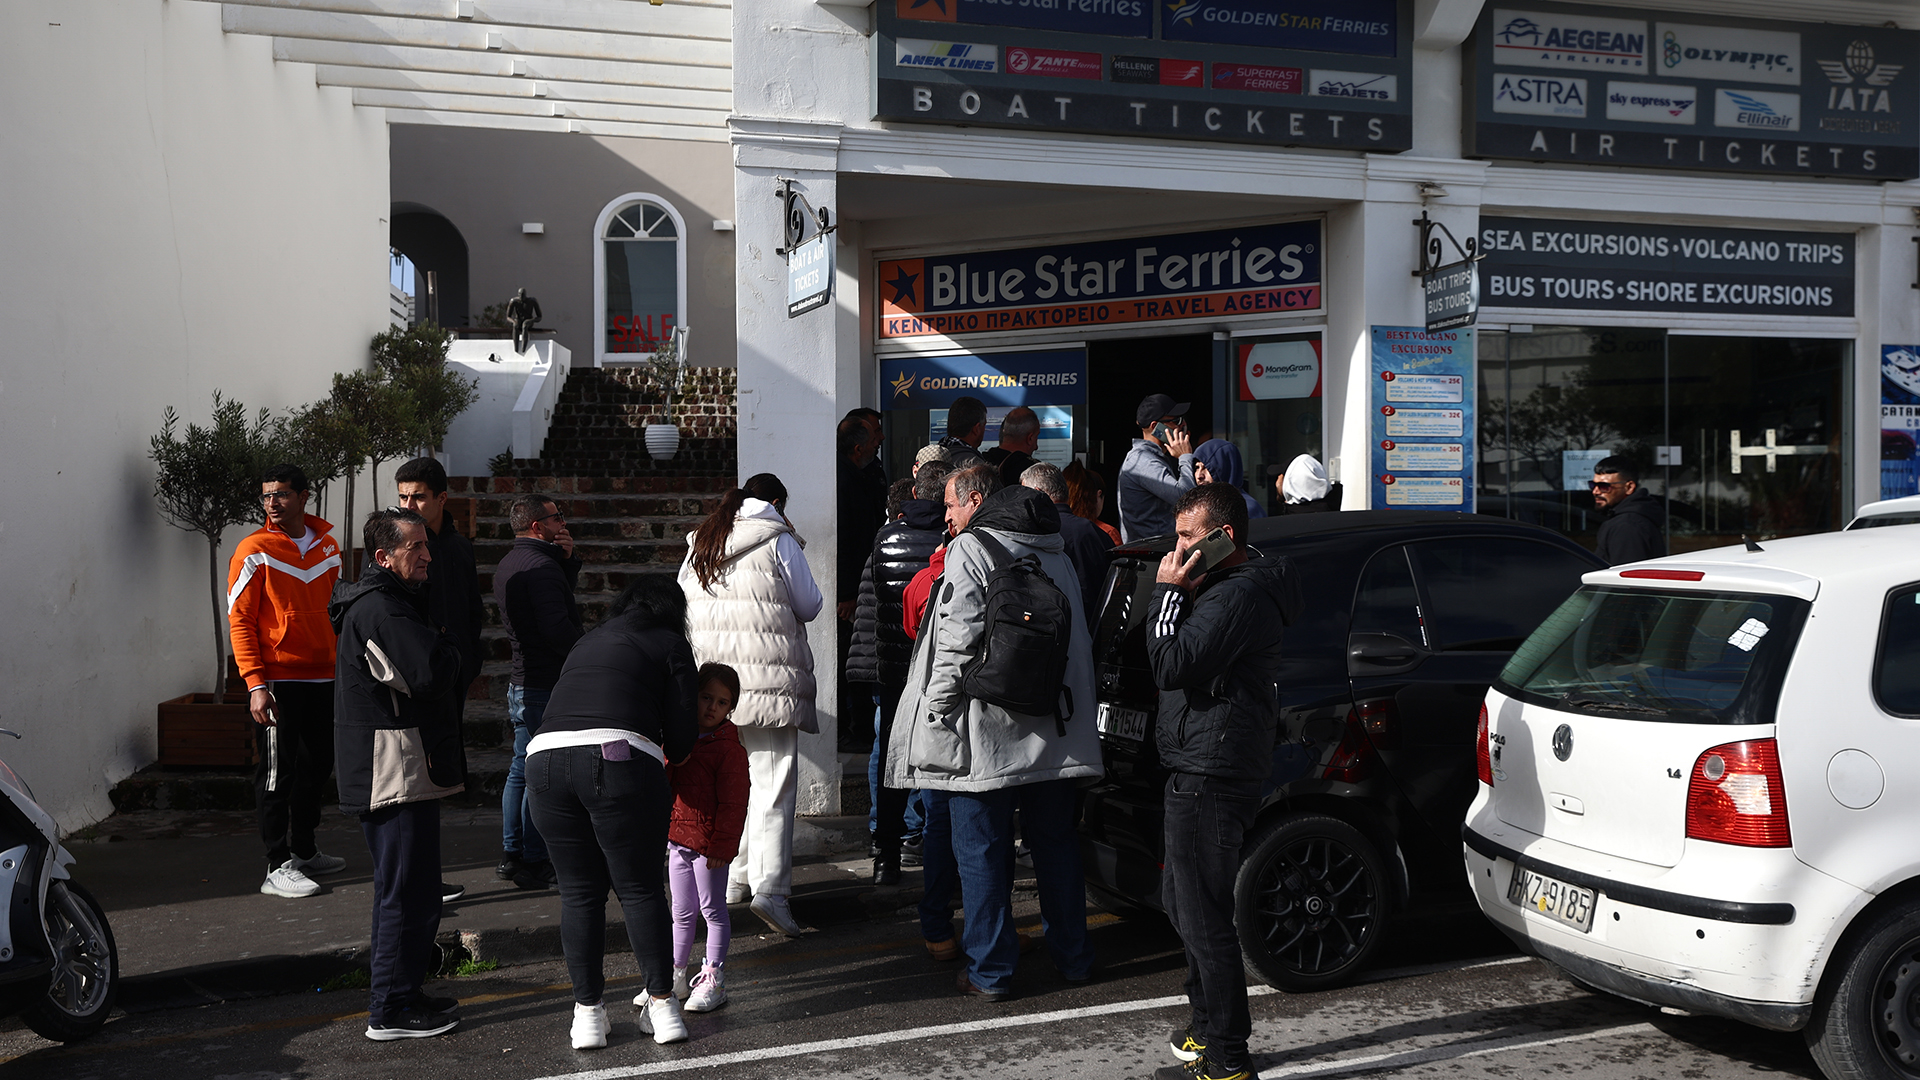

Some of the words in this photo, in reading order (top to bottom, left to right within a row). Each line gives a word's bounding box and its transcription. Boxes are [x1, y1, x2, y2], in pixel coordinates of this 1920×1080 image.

[1544, 27, 1644, 54] AEGEAN
[899, 54, 948, 67] ANEK
[948, 57, 995, 71] LINES
[1030, 55, 1079, 70] ZANTE
[1077, 62, 1101, 70] ferries
[1541, 53, 1642, 66] AIRLINES
[1684, 47, 1789, 66] OLYMPIC
[1114, 61, 1155, 71] HELLENIC
[1117, 69, 1152, 78] SEAWAYS
[1236, 67, 1300, 80] SUPERFAST
[1749, 64, 1793, 72] AIR
[1244, 79, 1289, 90] FERRIES
[1498, 77, 1583, 105] ASTRA
[1318, 86, 1389, 99] SEAJETS
[1609, 93, 1628, 106] sky
[1630, 96, 1671, 107] express
[1828, 86, 1892, 113] IATA
[912, 85, 1072, 120] BOAT
[1129, 102, 1383, 141] TICKETS
[1737, 111, 1792, 126] Ellinair
[1530, 130, 1615, 156] AIR
[1663, 137, 1876, 170] TICKETS
[1481, 229, 1526, 250] SEA
[1532, 231, 1669, 257] EXCURSIONS
[1680, 237, 1780, 261] VOLCANO
[1785, 242, 1844, 264] TRIPS
[790, 253, 806, 273] BOAT
[813, 243, 825, 263] AIR
[794, 268, 819, 293] TICKETS
[932, 262, 1026, 307] Blue
[1034, 254, 1126, 299] Star
[1427, 276, 1448, 295] BOAT
[1448, 270, 1471, 288] TRIPS
[1490, 275, 1535, 297] BUS
[1541, 277, 1615, 300] TOURS
[1625, 281, 1698, 303] SHORE
[1702, 283, 1833, 306] EXCURSIONS
[1427, 299, 1443, 314] BUS
[1444, 291, 1471, 310] TOURS
[888, 314, 979, 335] ΚΕΝΤΡΙΚΟ
[986, 304, 1110, 328] ΠΡΑΚΤΟΡΕΙΟ
[1133, 297, 1215, 319] TRAVEL
[1223, 288, 1314, 312] AGENCY
[612, 313, 673, 342] SALE
[1386, 330, 1410, 340] BEST
[1412, 331, 1458, 341] VOLCANO
[613, 344, 625, 353] UP
[626, 343, 637, 353] TO
[1391, 344, 1453, 355] EXCURSIONS
[1385, 372, 1390, 380] 1
[1385, 406, 1391, 415] 2
[1385, 441, 1391, 449] 3
[1385, 475, 1391, 483] 4
[1490, 732, 1506, 746] POLO
